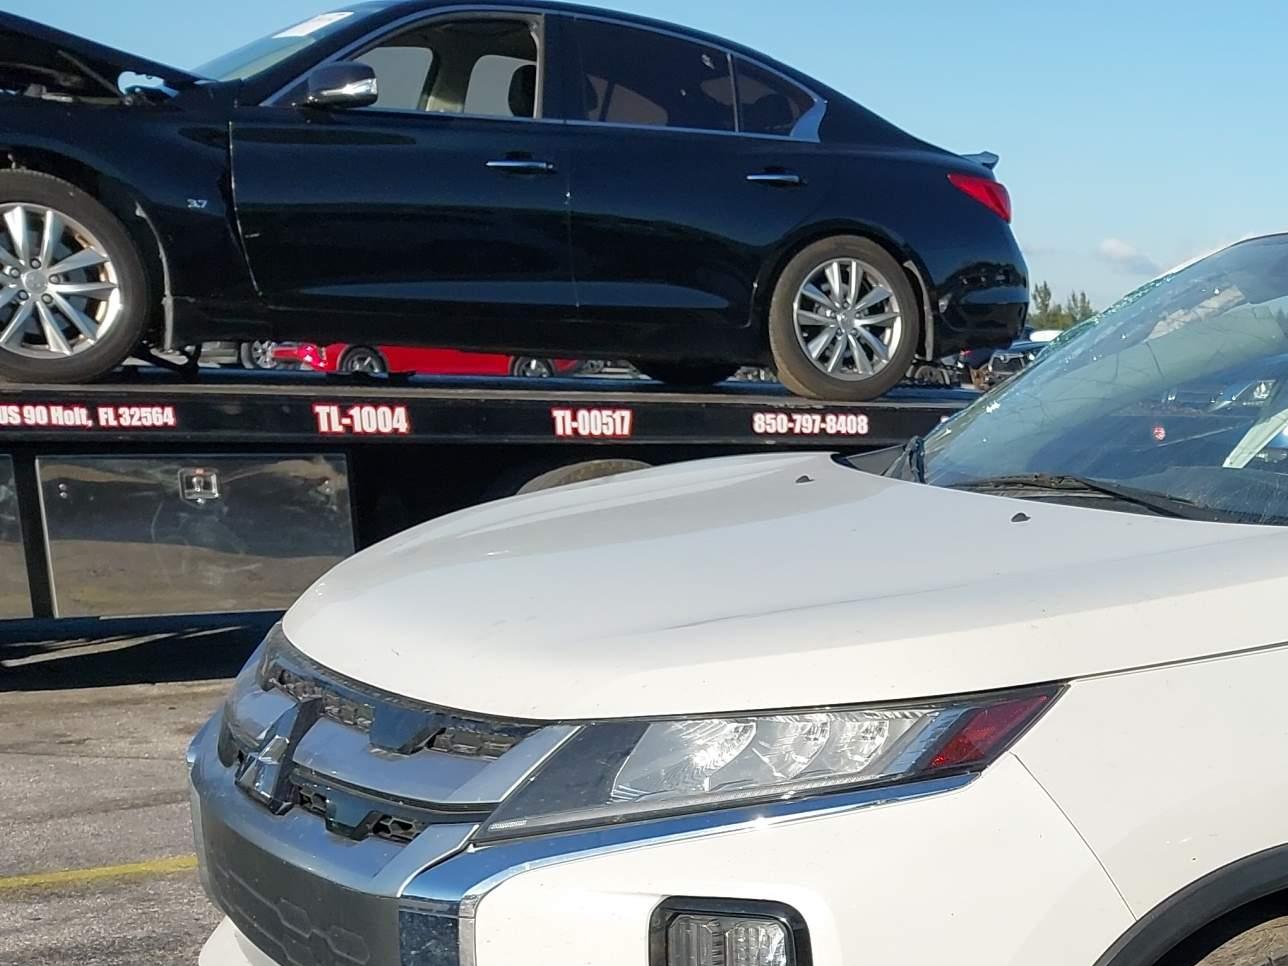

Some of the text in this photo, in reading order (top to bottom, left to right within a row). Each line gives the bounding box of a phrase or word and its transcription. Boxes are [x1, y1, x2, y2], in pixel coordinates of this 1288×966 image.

[23, 405, 48, 425] 90
[50, 405, 93, 427] Holt,
[98, 406, 119, 427] FL
[119, 406, 176, 427] 32564
[313, 404, 410, 434] TL-1004
[752, 412, 870, 435] 850-797-8408
